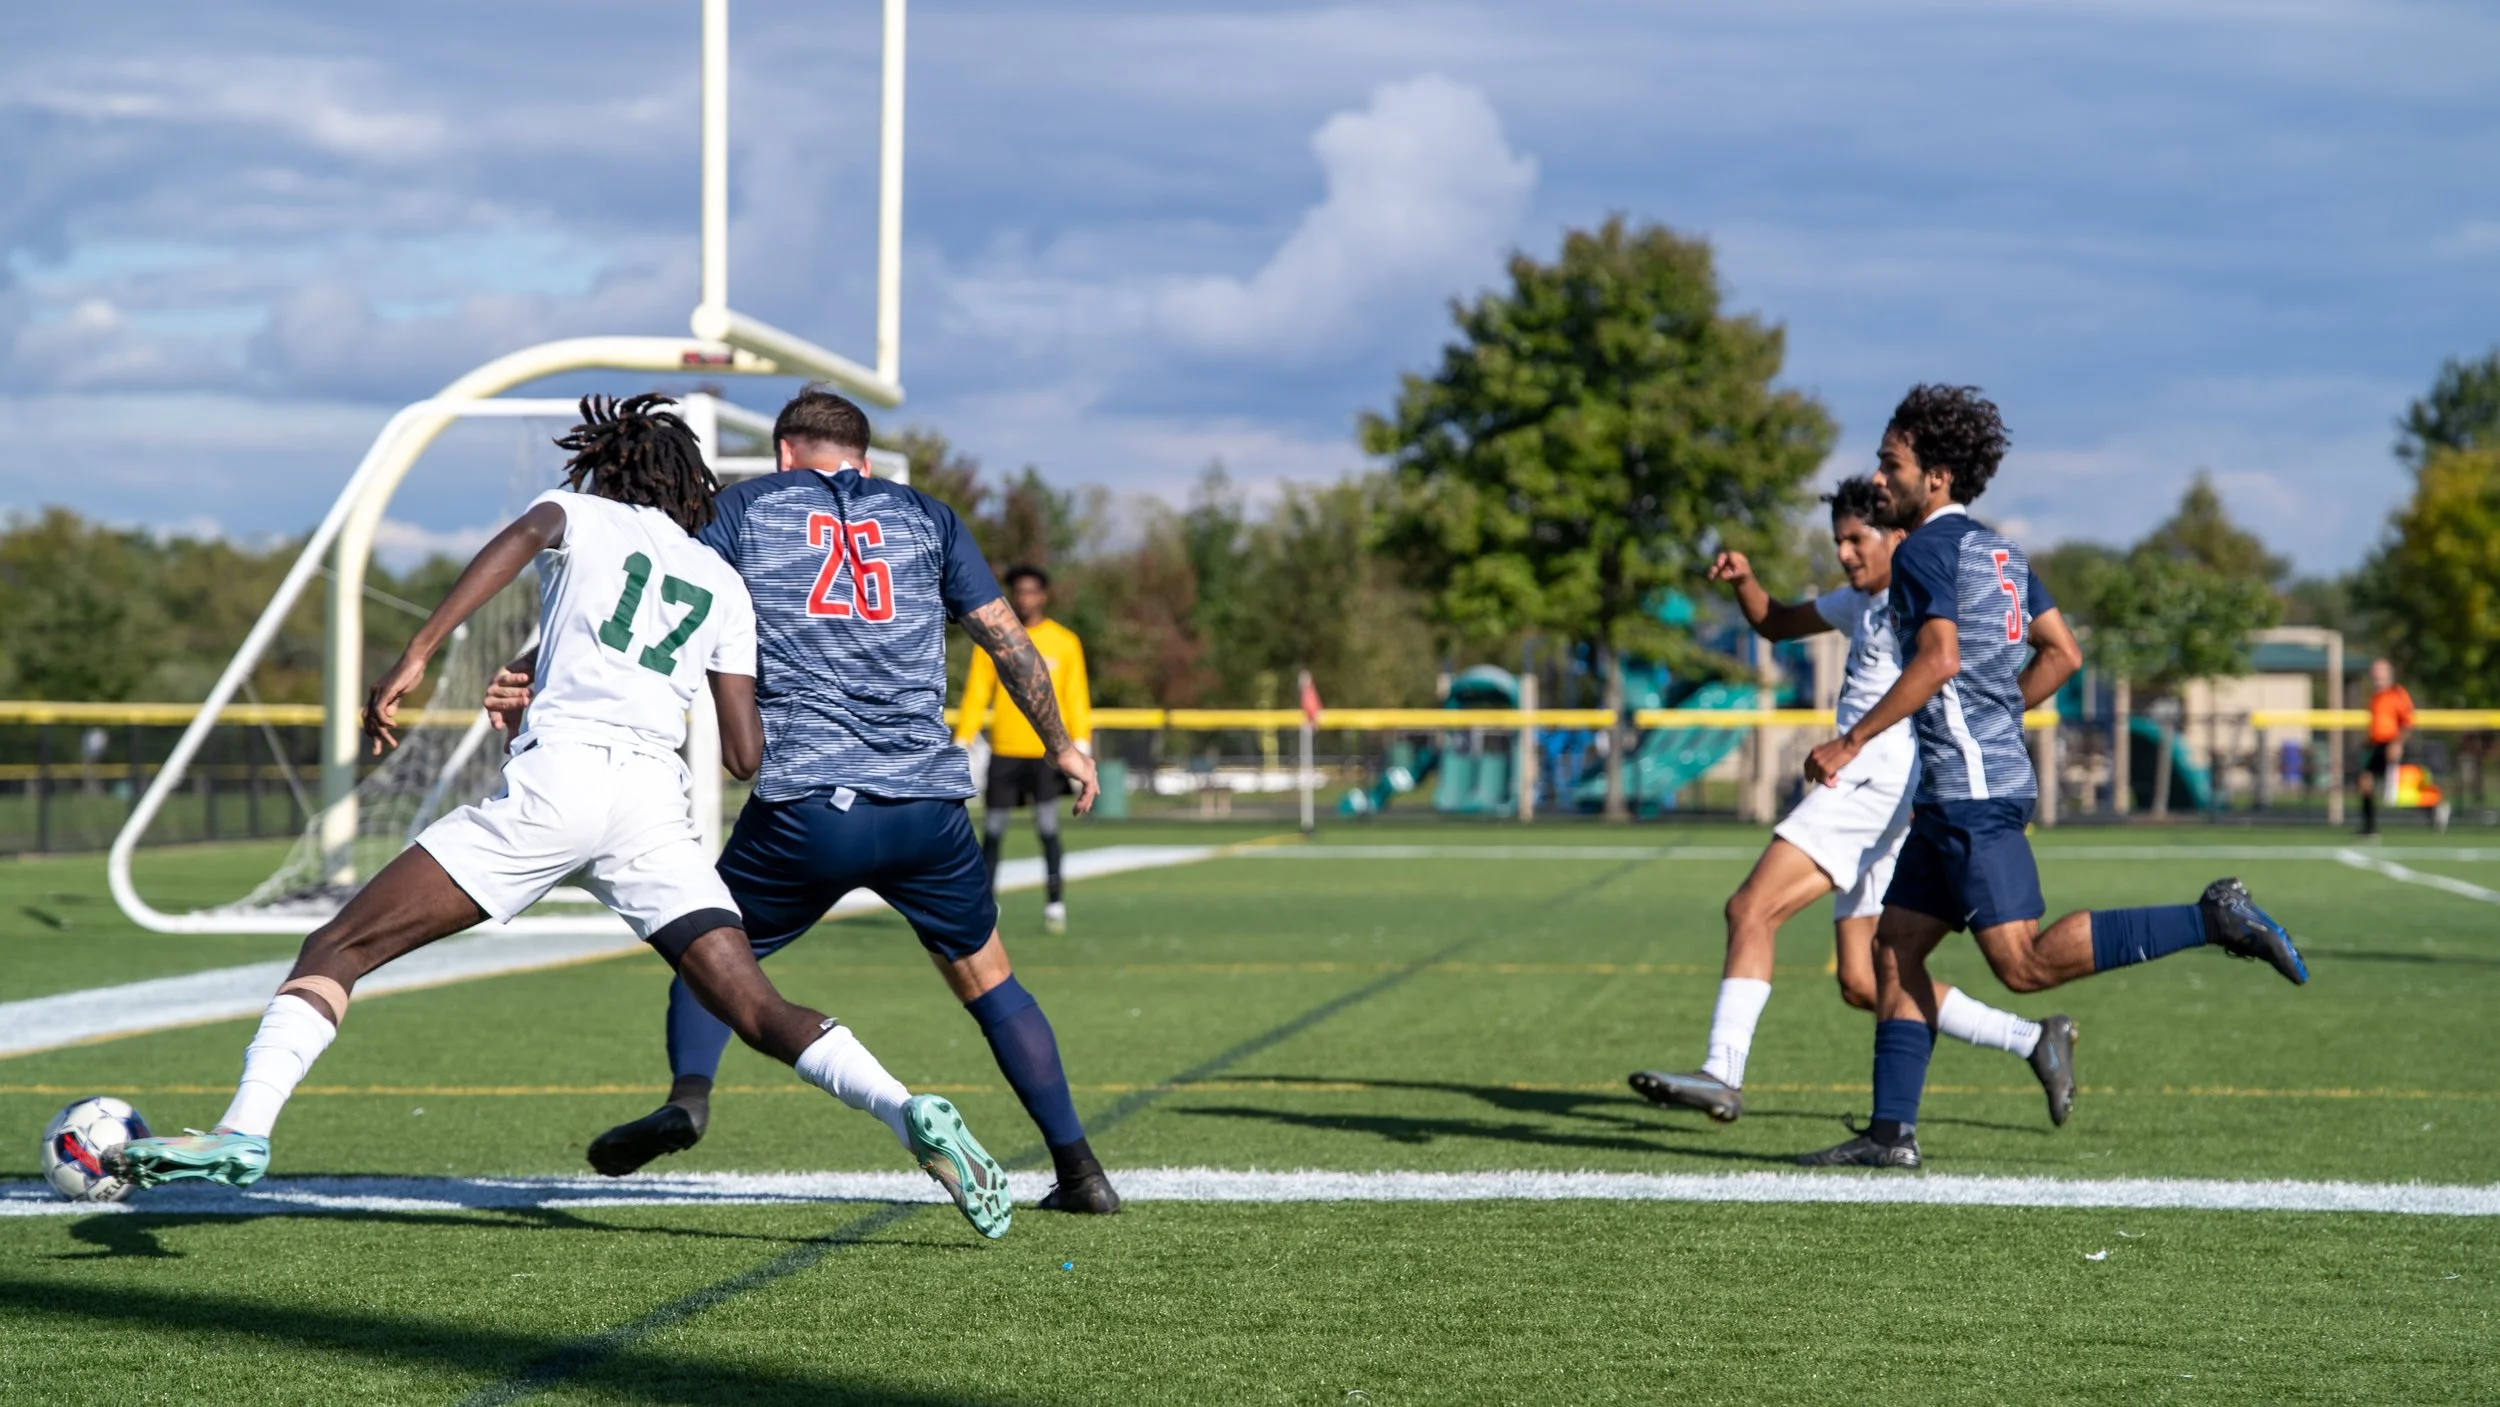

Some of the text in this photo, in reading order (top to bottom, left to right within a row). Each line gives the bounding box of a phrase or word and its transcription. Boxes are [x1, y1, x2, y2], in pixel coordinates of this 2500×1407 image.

[598, 551, 713, 676] 17
[806, 511, 896, 624] 26
[1991, 549, 2022, 644] 5
